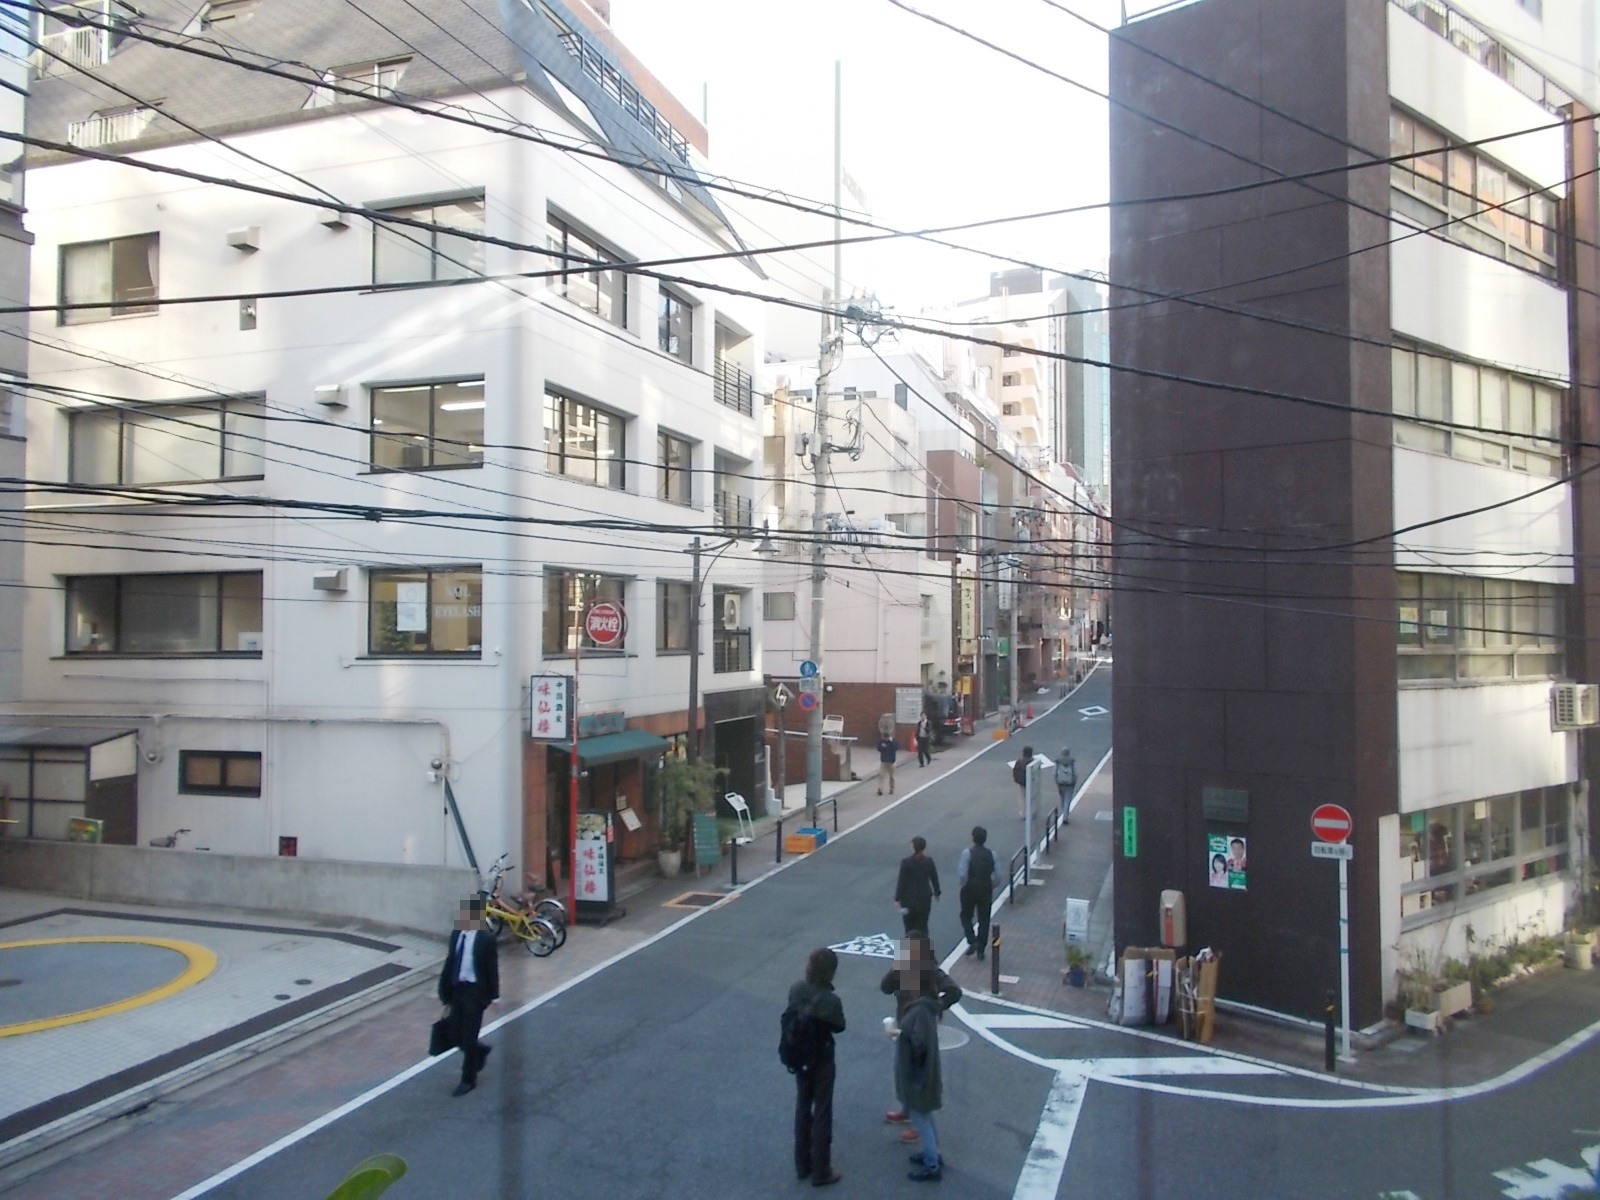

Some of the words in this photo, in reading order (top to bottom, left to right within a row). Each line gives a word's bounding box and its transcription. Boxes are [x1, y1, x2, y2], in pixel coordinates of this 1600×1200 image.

[435, 605, 481, 617] EYELASH
[590, 616, 618, 632] 消火栓
